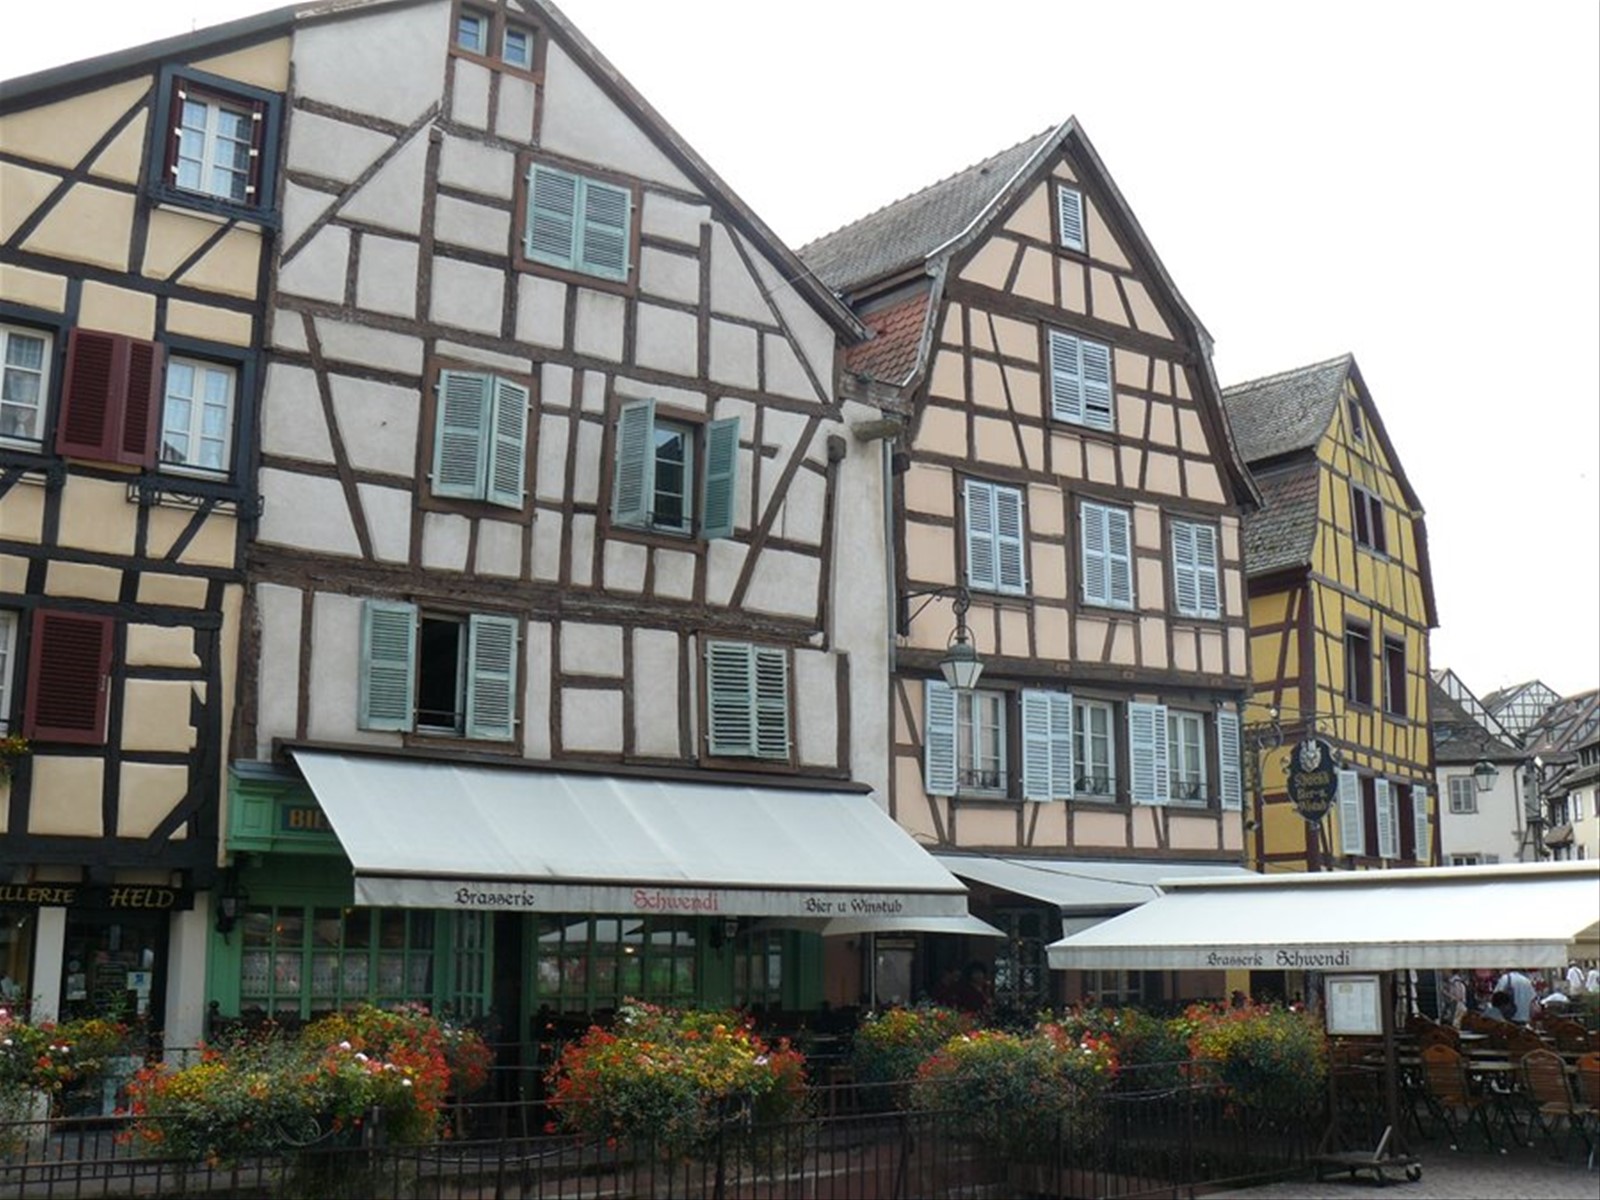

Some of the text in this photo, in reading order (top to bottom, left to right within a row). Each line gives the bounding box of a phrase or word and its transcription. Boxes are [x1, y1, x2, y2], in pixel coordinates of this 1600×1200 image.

[110, 887, 175, 908] HELD
[454, 887, 535, 907] Brasserie
[633, 889, 719, 911] Schwendi
[803, 897, 832, 913] Bier
[850, 898, 903, 914] Winstub
[1206, 949, 1350, 968] Brasserie Schwendi
